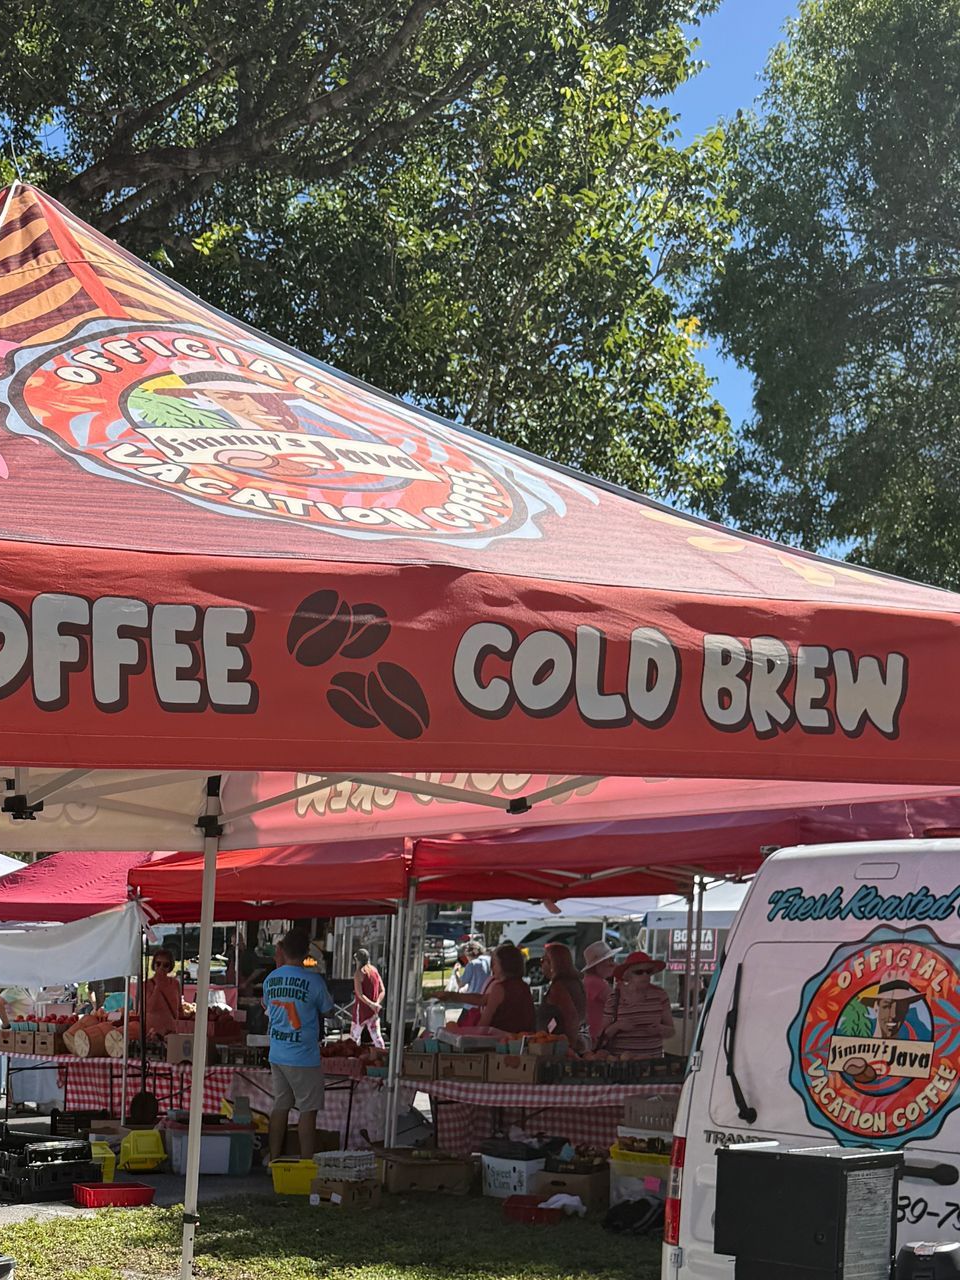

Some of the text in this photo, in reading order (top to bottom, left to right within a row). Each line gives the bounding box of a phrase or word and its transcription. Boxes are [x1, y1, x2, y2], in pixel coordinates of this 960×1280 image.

[53, 335, 329, 399] OFFICIAL
[154, 432, 423, 472] Jimmy's Java
[102, 441, 511, 532] VACATION COFFEE
[453, 622, 907, 740] COLD BREW
[840, 883, 960, 922] Roasted
[285, 976, 310, 993] LOCAL
[837, 949, 949, 993] OFFICIAL
[267, 986, 309, 1003] PRODUCE
[271, 1027, 302, 1043] PEOPLE
[831, 1041, 930, 1069] Jimmy's Java
[807, 1058, 957, 1132] VACATION COFFEE
